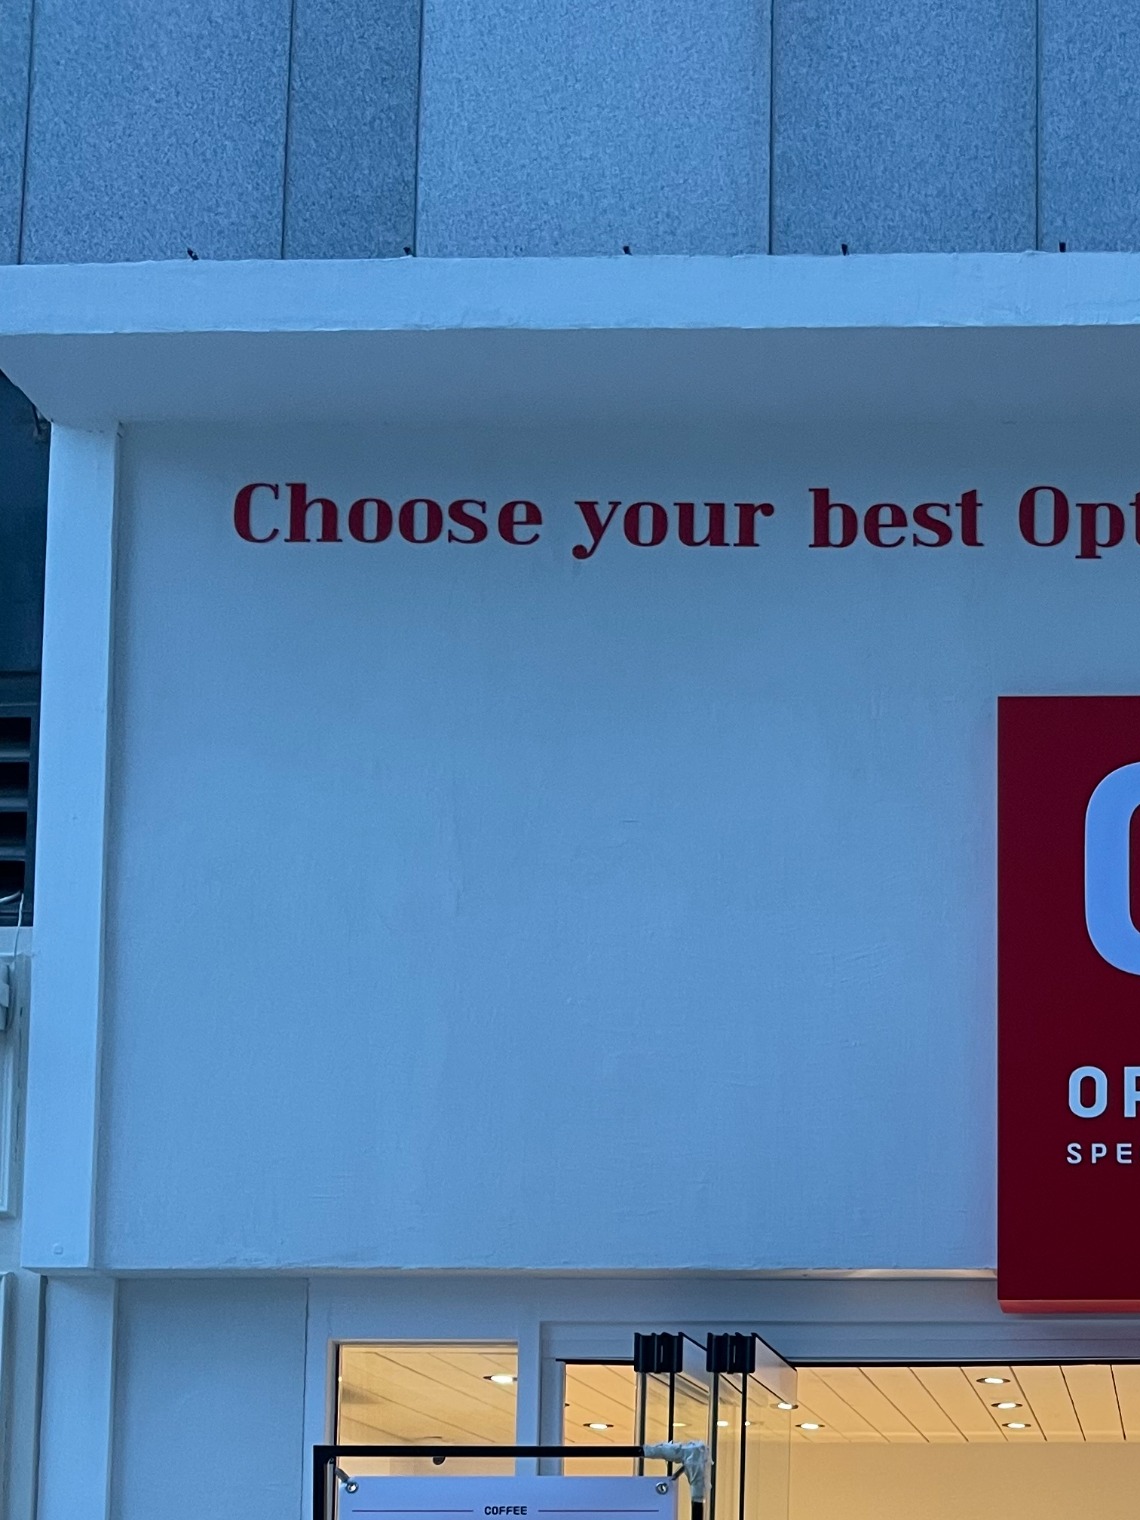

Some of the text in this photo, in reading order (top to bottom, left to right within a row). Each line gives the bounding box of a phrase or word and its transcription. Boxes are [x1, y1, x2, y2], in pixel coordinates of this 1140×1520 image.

[233, 482, 543, 544] Choose
[571, 499, 775, 560] your
[808, 487, 984, 548] best
[483, 1505, 528, 1516] COFFEE
